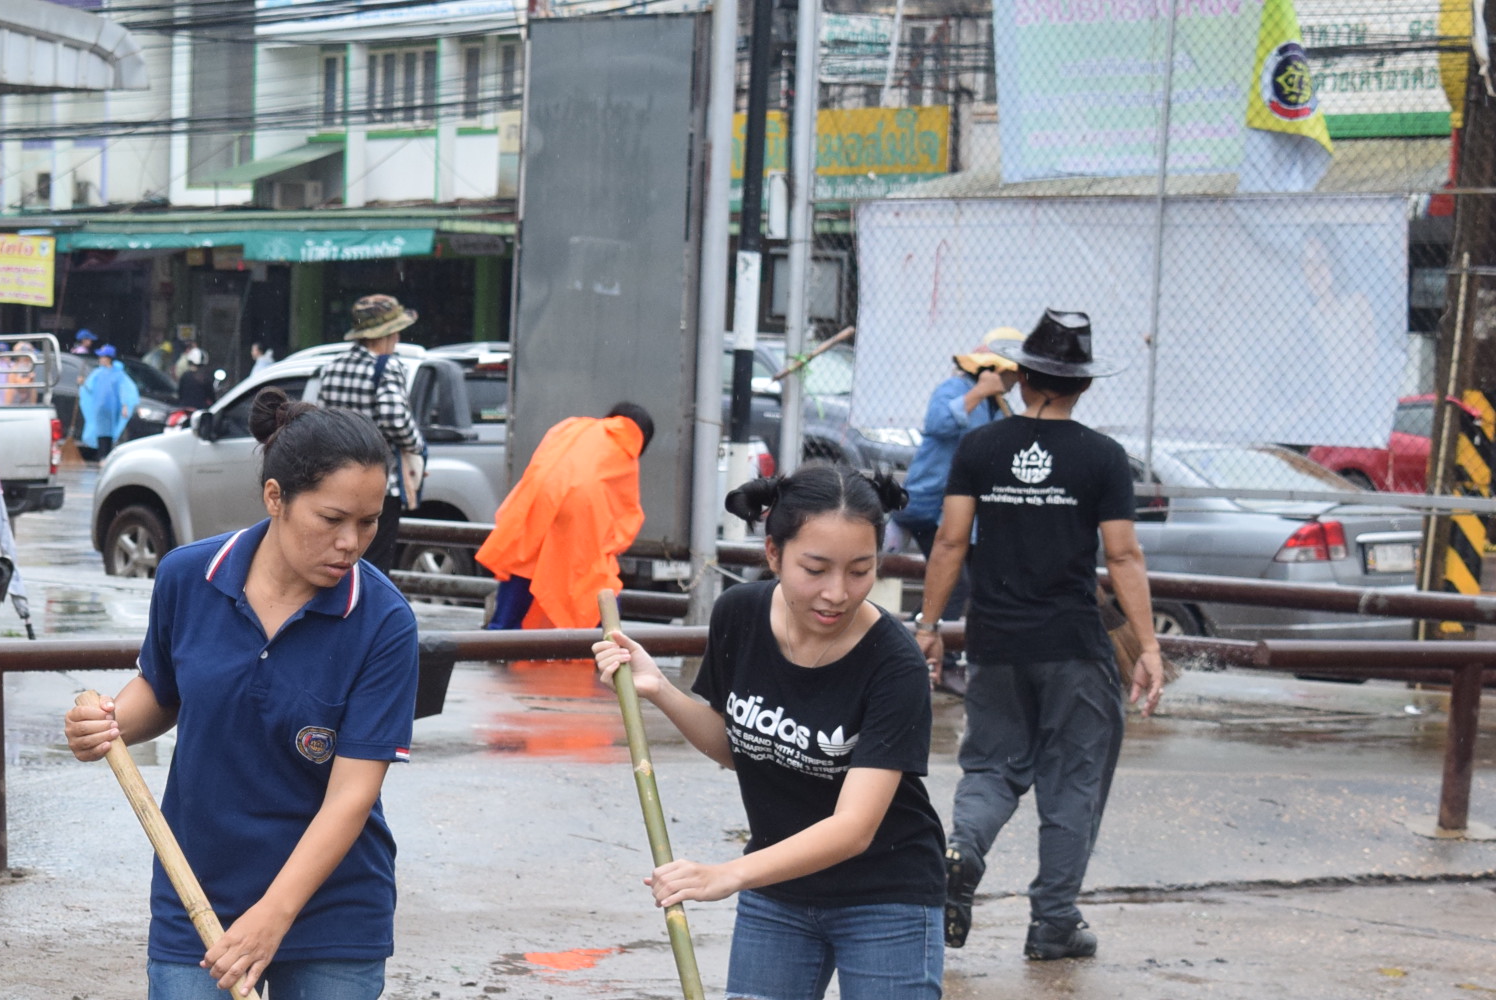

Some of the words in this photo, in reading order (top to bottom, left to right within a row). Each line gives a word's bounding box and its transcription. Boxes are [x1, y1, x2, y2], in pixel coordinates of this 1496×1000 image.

[726, 691, 811, 750] adidas
[743, 732, 772, 747] BRAND
[773, 741, 794, 757] WITH
[801, 752, 834, 767] STRIPES
